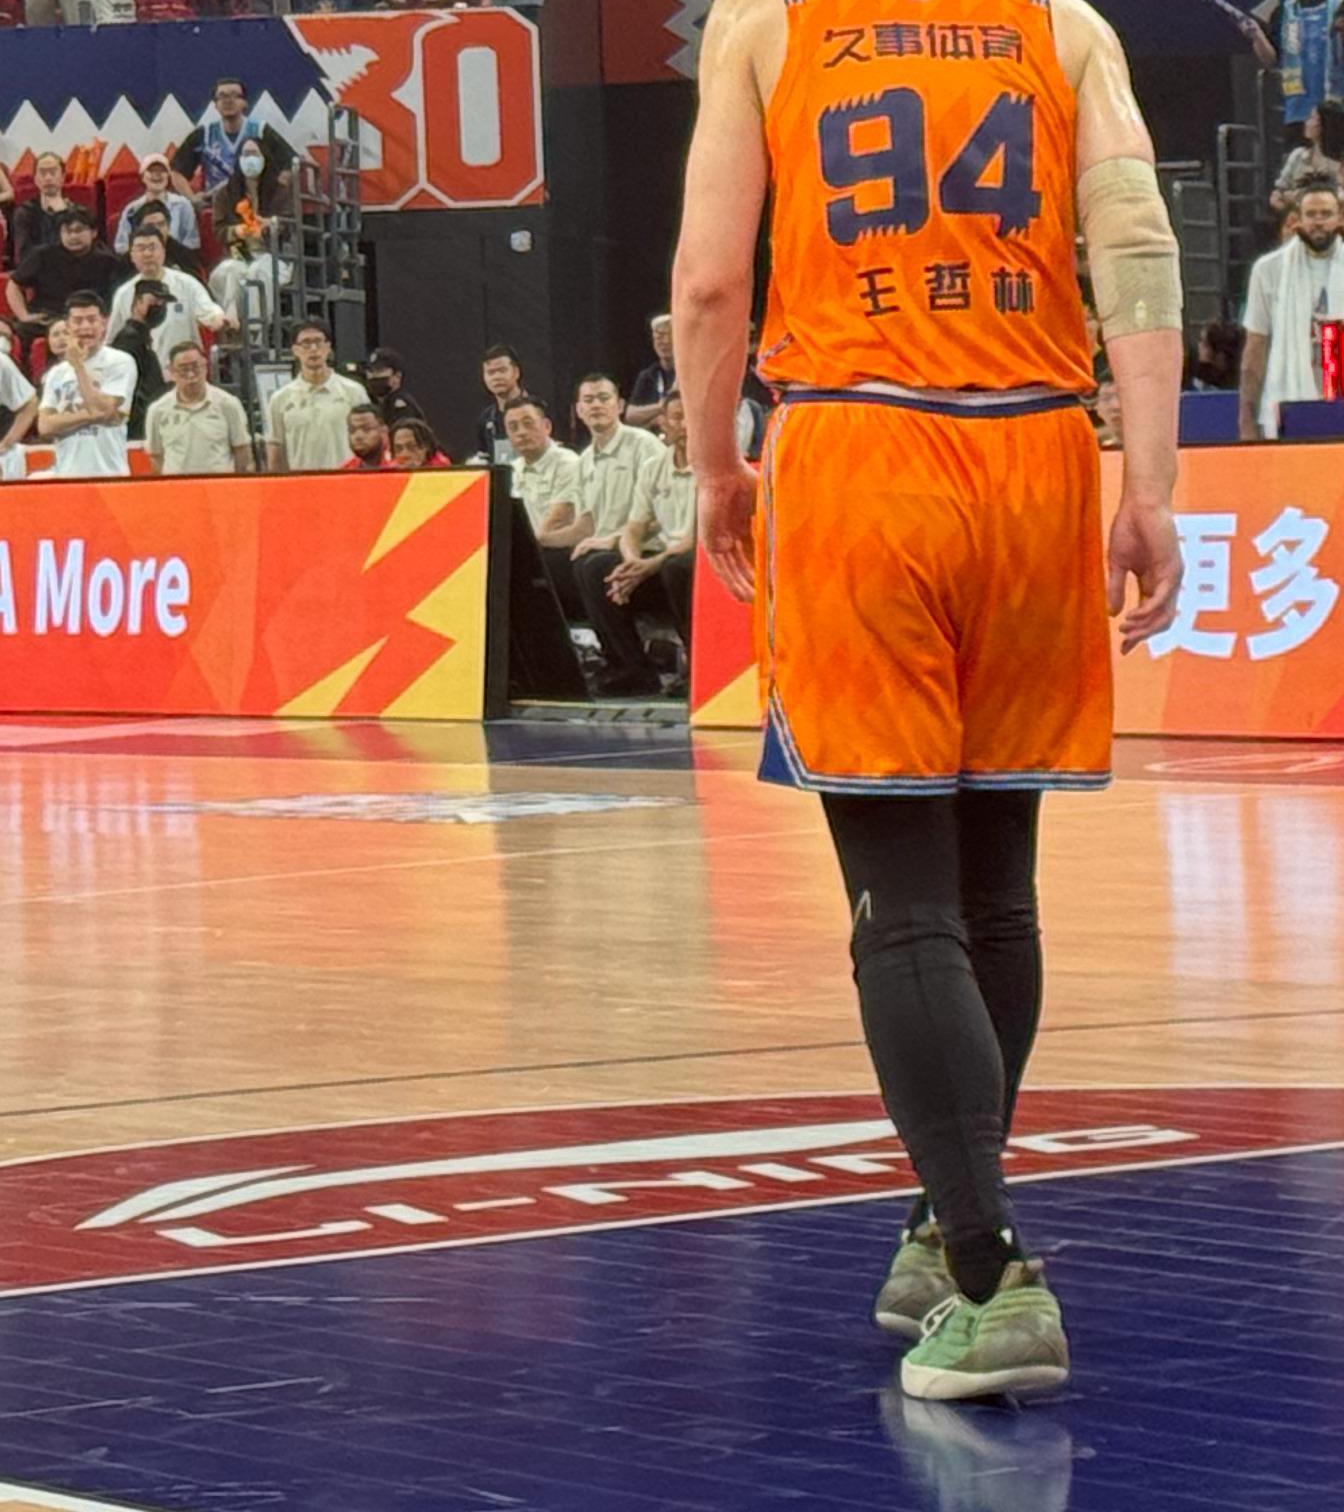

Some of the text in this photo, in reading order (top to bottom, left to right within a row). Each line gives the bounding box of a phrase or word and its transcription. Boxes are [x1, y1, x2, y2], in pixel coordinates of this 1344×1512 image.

[822, 22, 1023, 69] 久事体育
[817, 86, 1042, 247] 94
[856, 260, 1036, 318] 王哲林
[34, 538, 191, 638] More
